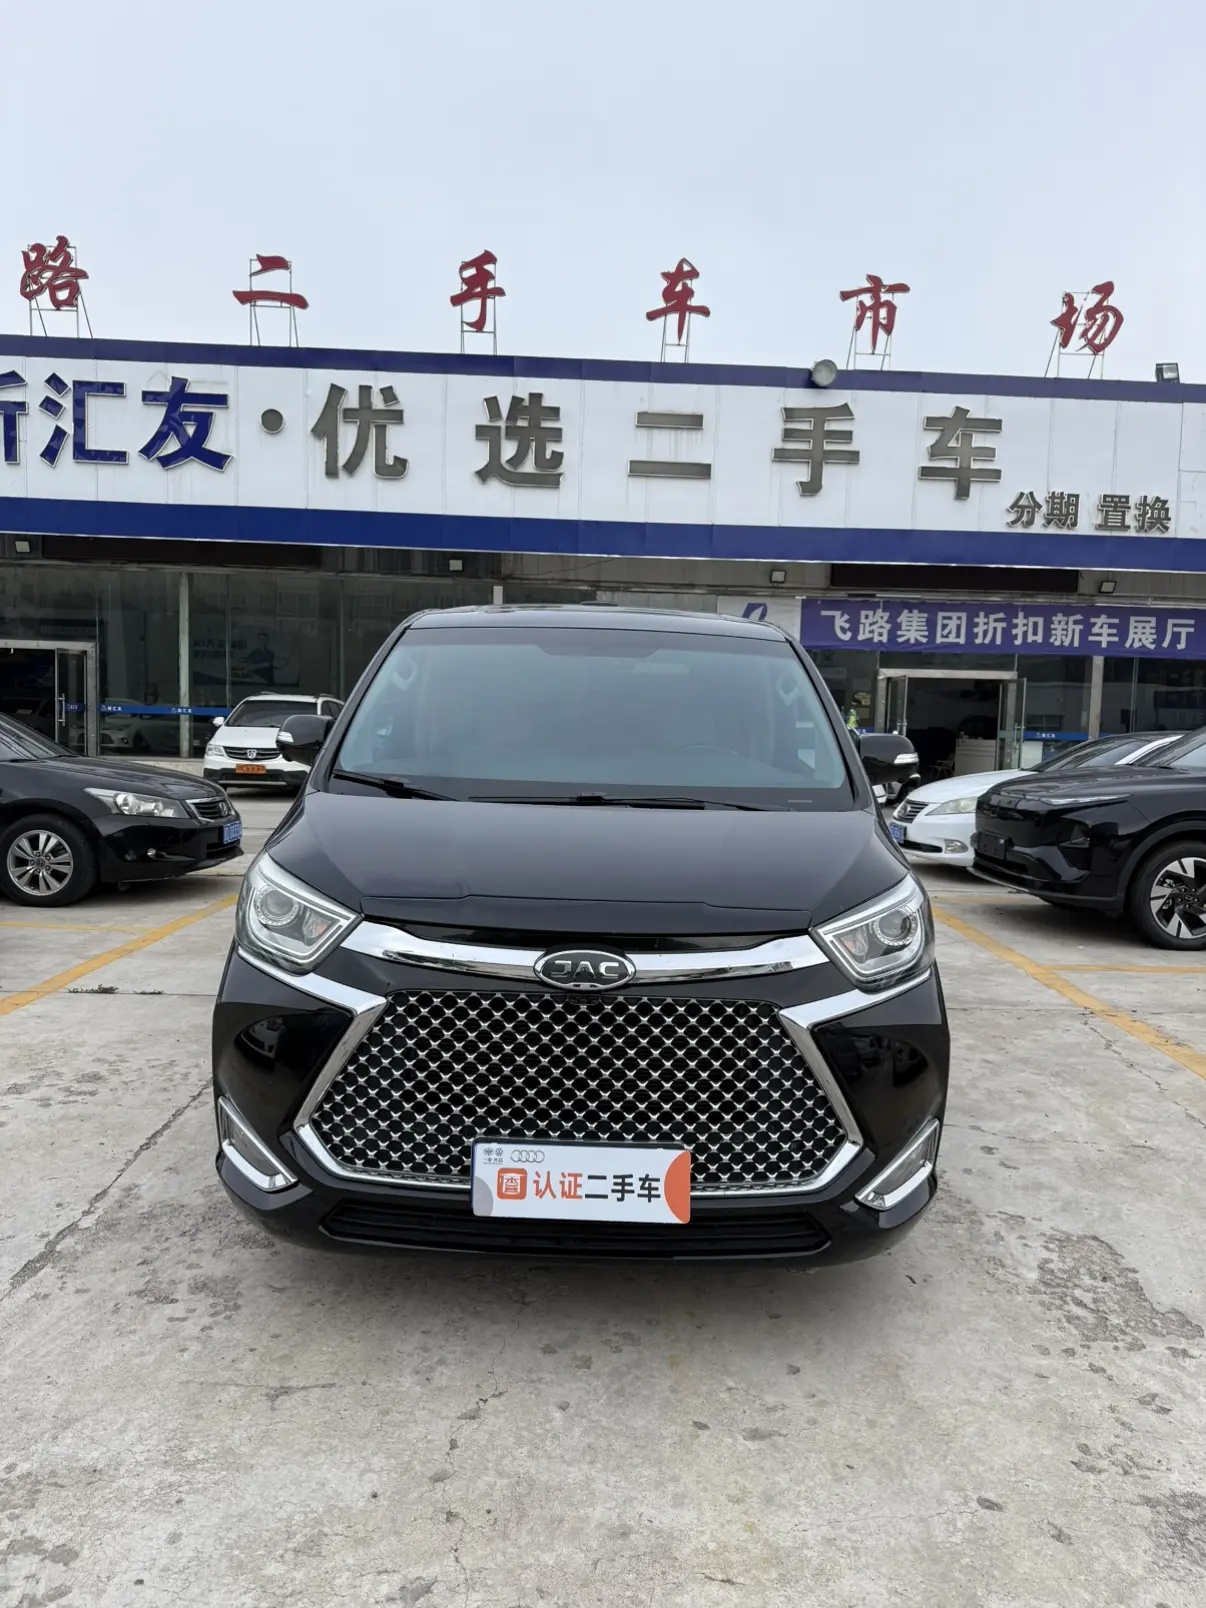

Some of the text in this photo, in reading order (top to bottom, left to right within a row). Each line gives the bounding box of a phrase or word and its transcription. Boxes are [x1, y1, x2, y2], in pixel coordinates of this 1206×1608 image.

[1006, 491, 1171, 533] 分期 置换
[820, 608, 1196, 651] 飞路集团折扣新车展厅
[551, 961, 619, 978] JAC
[533, 1170, 661, 1203] 认证二手车
